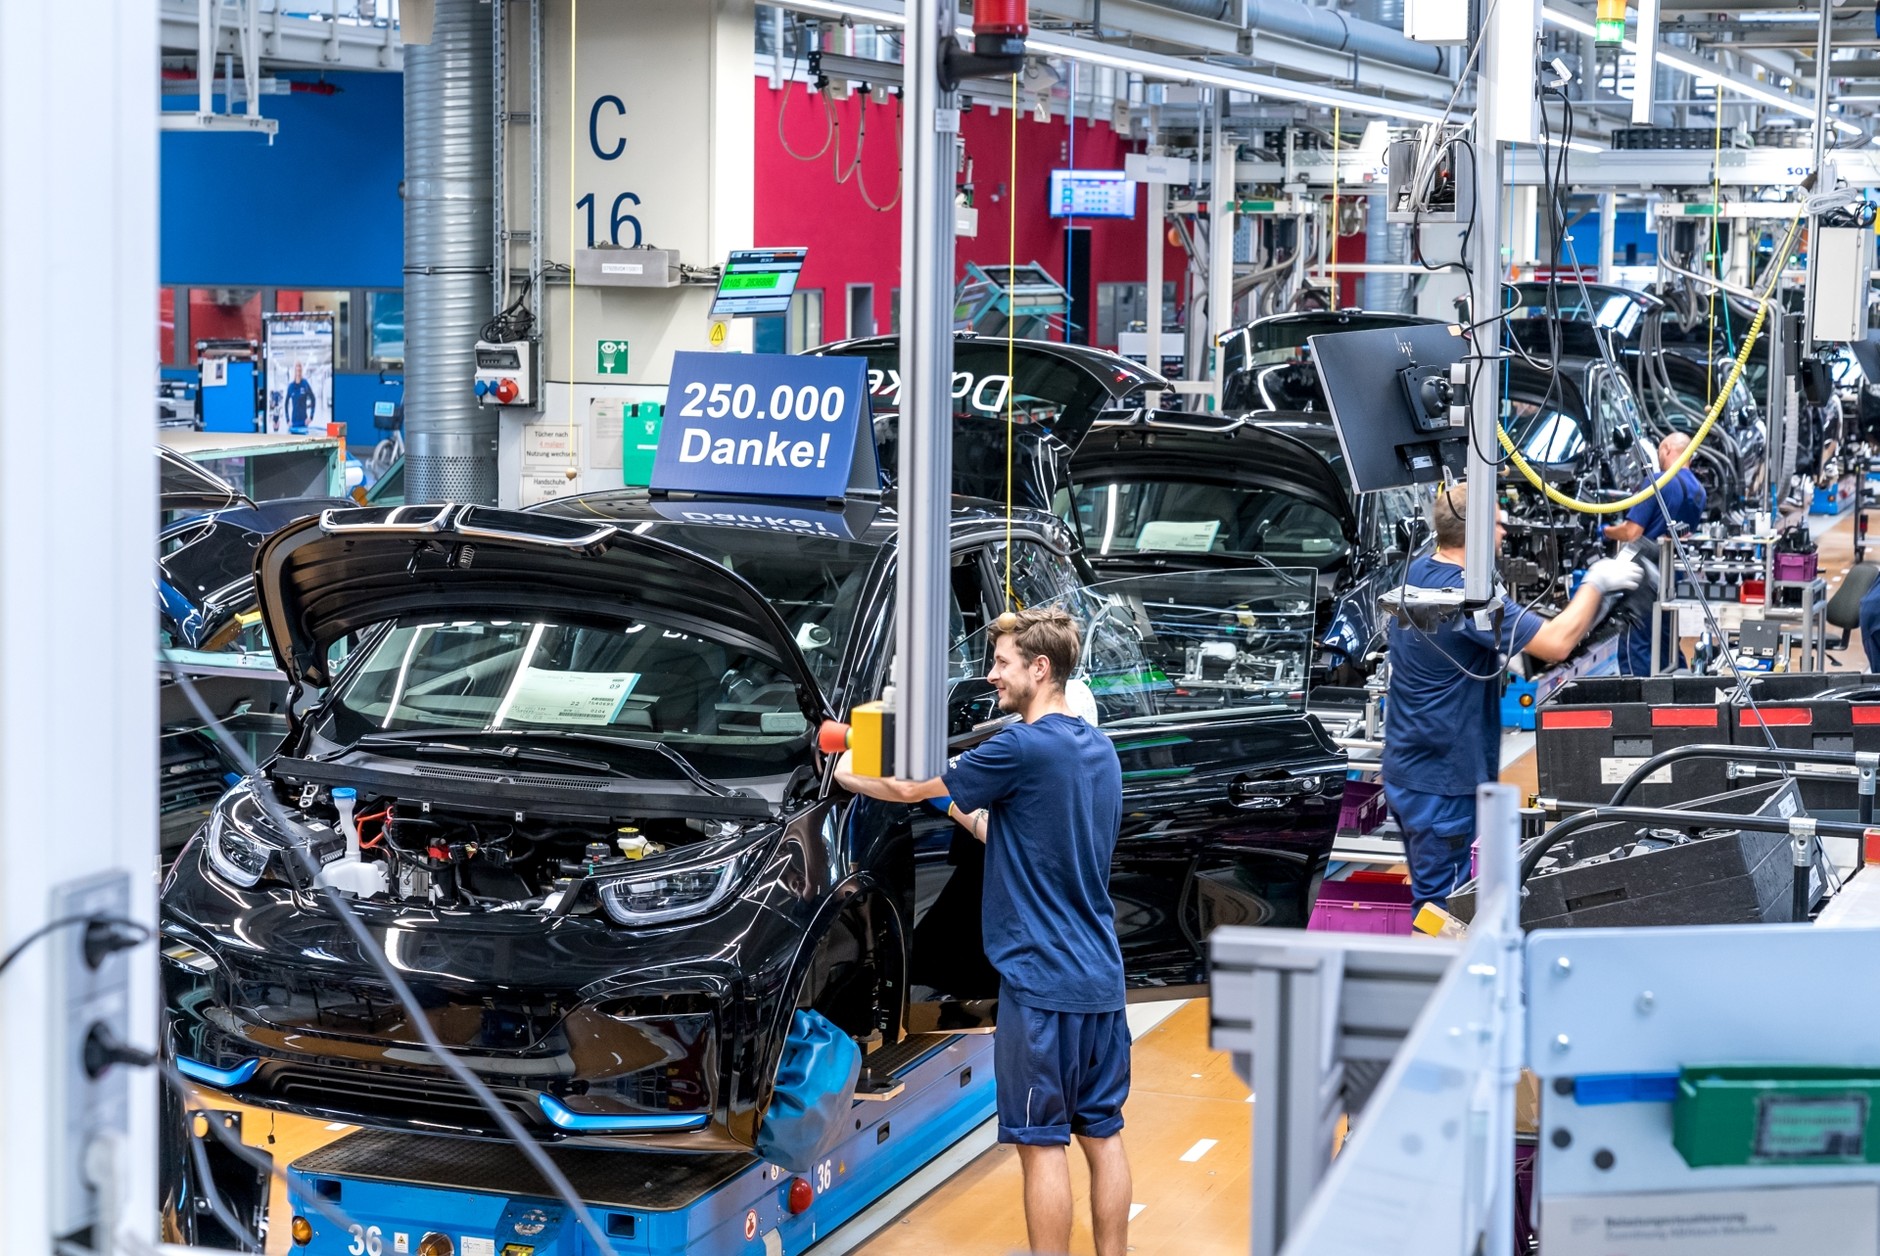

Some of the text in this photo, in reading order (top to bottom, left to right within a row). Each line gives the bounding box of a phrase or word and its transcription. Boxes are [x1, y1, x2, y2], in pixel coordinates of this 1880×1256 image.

[589, 94, 627, 161] C
[575, 191, 642, 249] 16
[679, 382, 845, 422] 250.000
[868, 369, 1014, 413] Dake
[526, 450, 550, 458] Nutzung
[679, 427, 831, 469] Danke!
[817, 1159, 832, 1194] 36
[347, 1223, 383, 1256] 36
